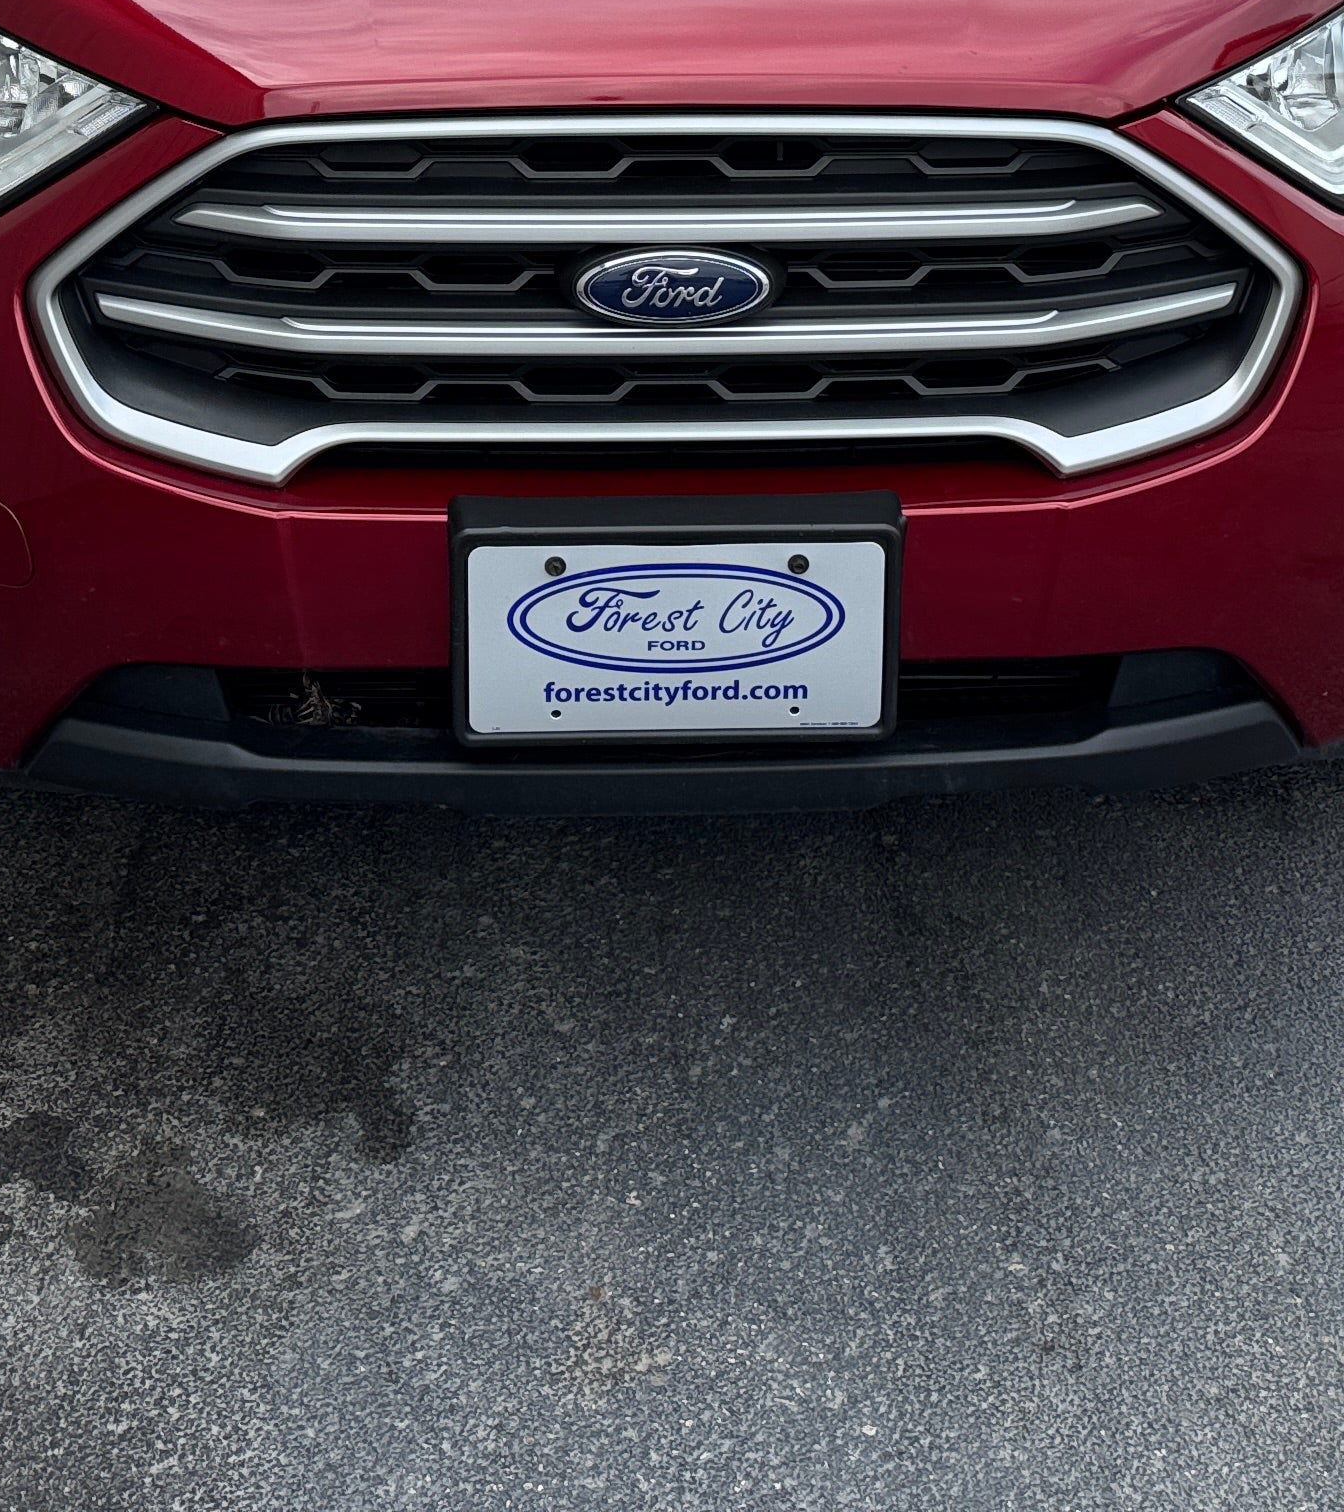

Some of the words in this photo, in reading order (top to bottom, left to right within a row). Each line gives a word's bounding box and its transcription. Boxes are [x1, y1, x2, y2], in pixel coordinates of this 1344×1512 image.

[621, 266, 724, 308] Ford
[566, 587, 704, 632] Forest
[718, 589, 794, 648] City
[647, 640, 706, 651] FORD
[544, 680, 808, 706] forestcityford.com
